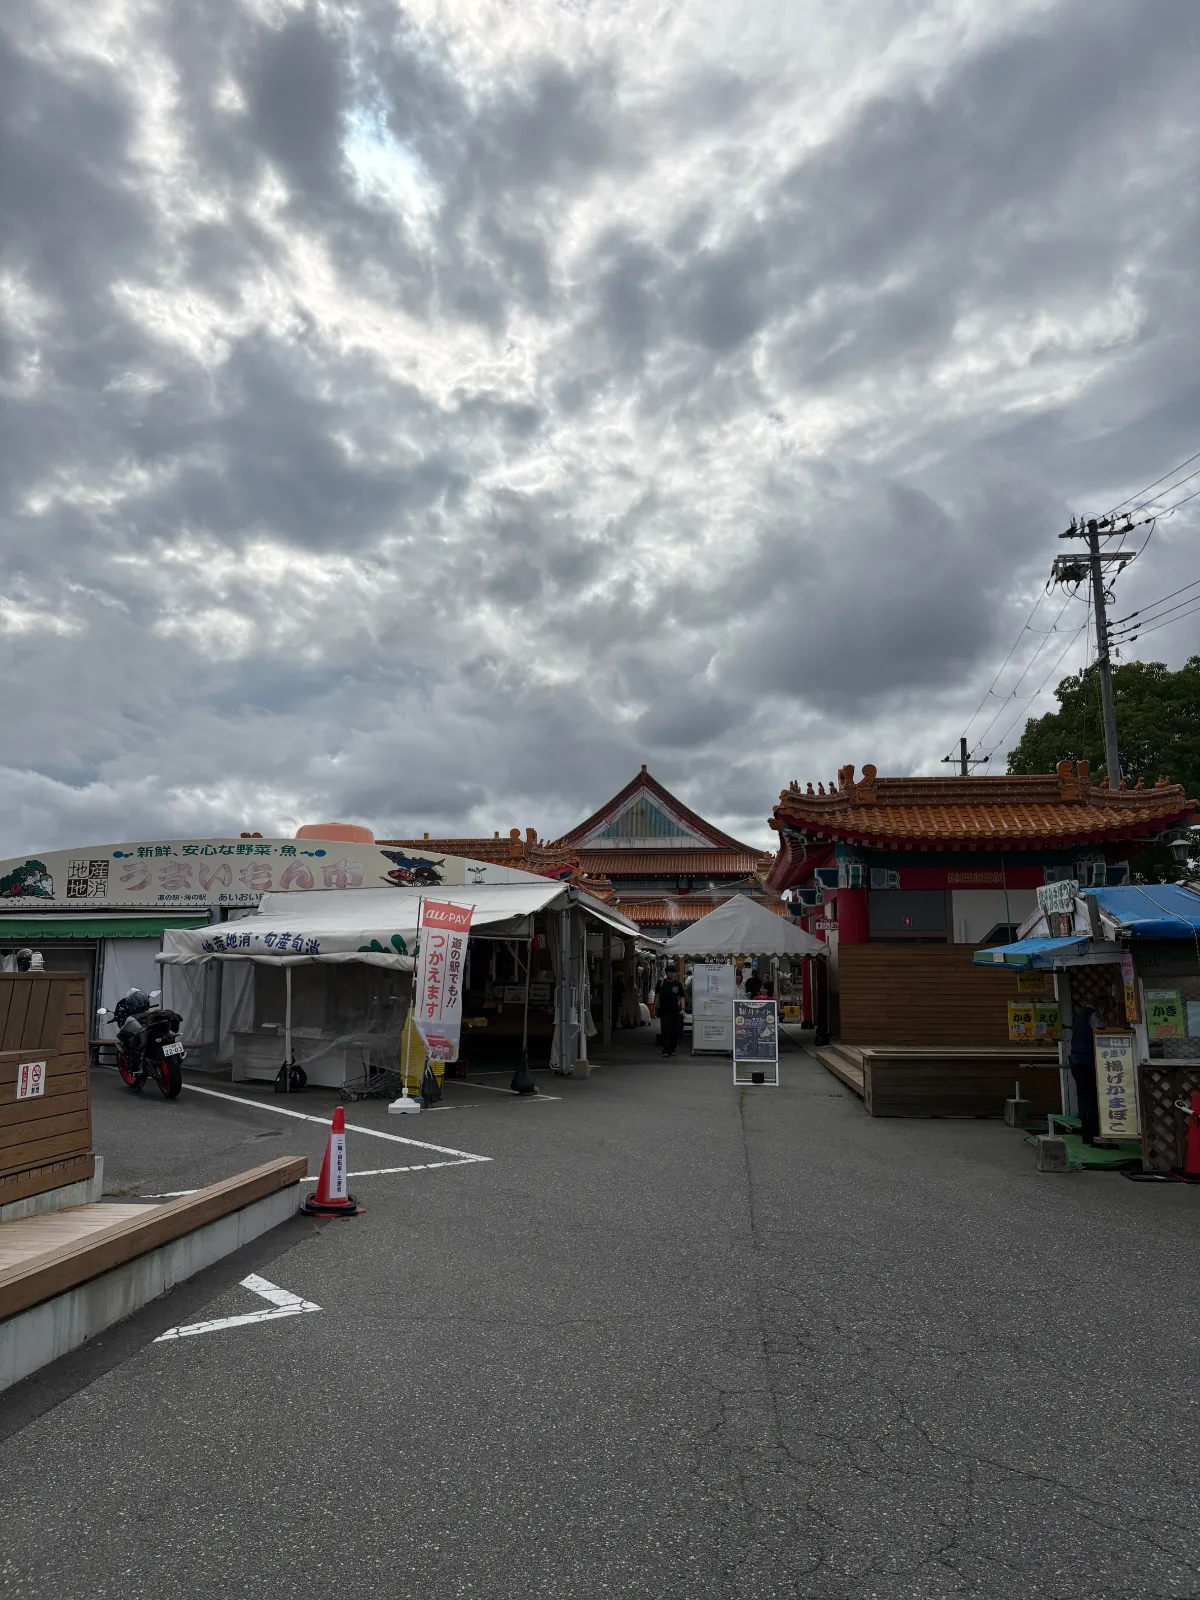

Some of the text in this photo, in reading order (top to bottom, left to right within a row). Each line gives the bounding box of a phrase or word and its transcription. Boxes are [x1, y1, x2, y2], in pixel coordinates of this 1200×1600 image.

[137, 844, 296, 858] 新鮮、安心な野菜・魚
[120, 860, 366, 891] うまいもん市
[426, 908, 471, 925] au PAY
[425, 935, 446, 1018] つかえます
[1153, 1005, 1177, 1017] かき
[1101, 1049, 1127, 1058] 手造り
[1105, 1060, 1128, 1133] 揚げかまぼこ
